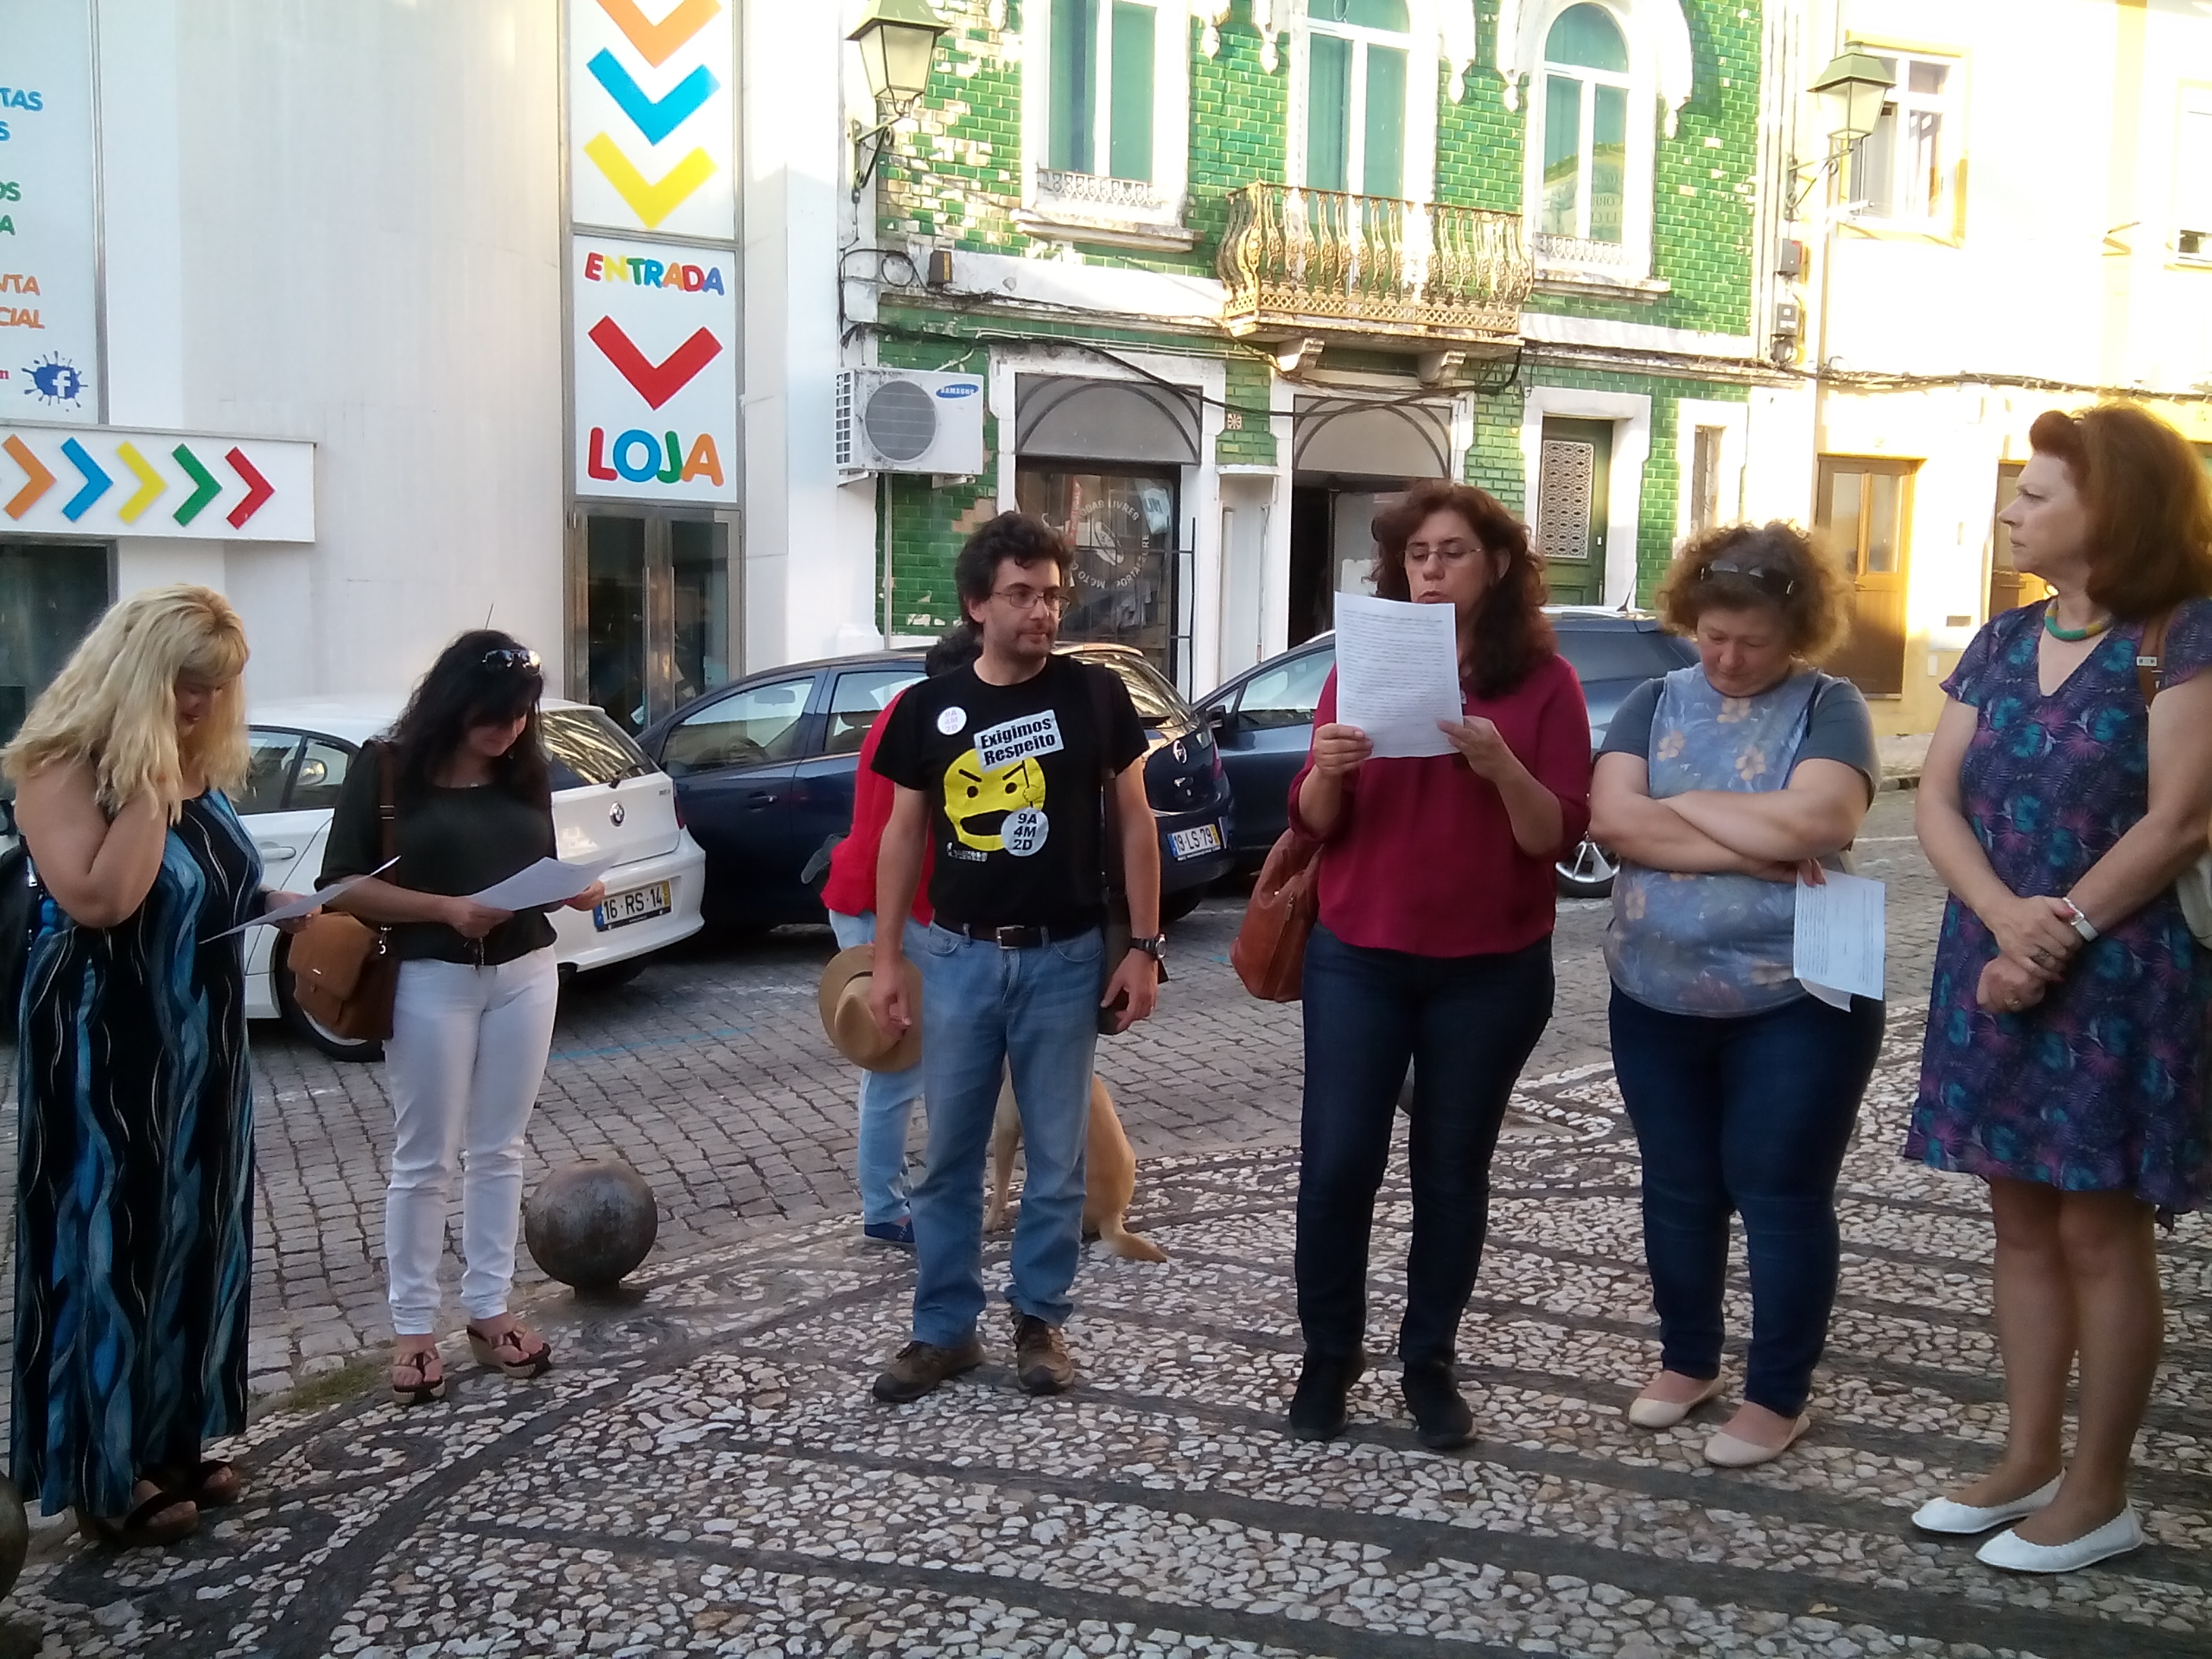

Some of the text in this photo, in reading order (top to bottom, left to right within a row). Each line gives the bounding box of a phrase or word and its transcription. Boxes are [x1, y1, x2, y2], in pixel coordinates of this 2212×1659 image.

[585, 251, 725, 296] ENTRADA
[588, 426, 724, 487] LOJA
[981, 718, 1052, 749] Exigimos
[984, 735, 1055, 766] Respeito
[1014, 826, 1036, 837] 4M
[1018, 813, 1037, 824] 9A
[1013, 839, 1033, 851] 2D
